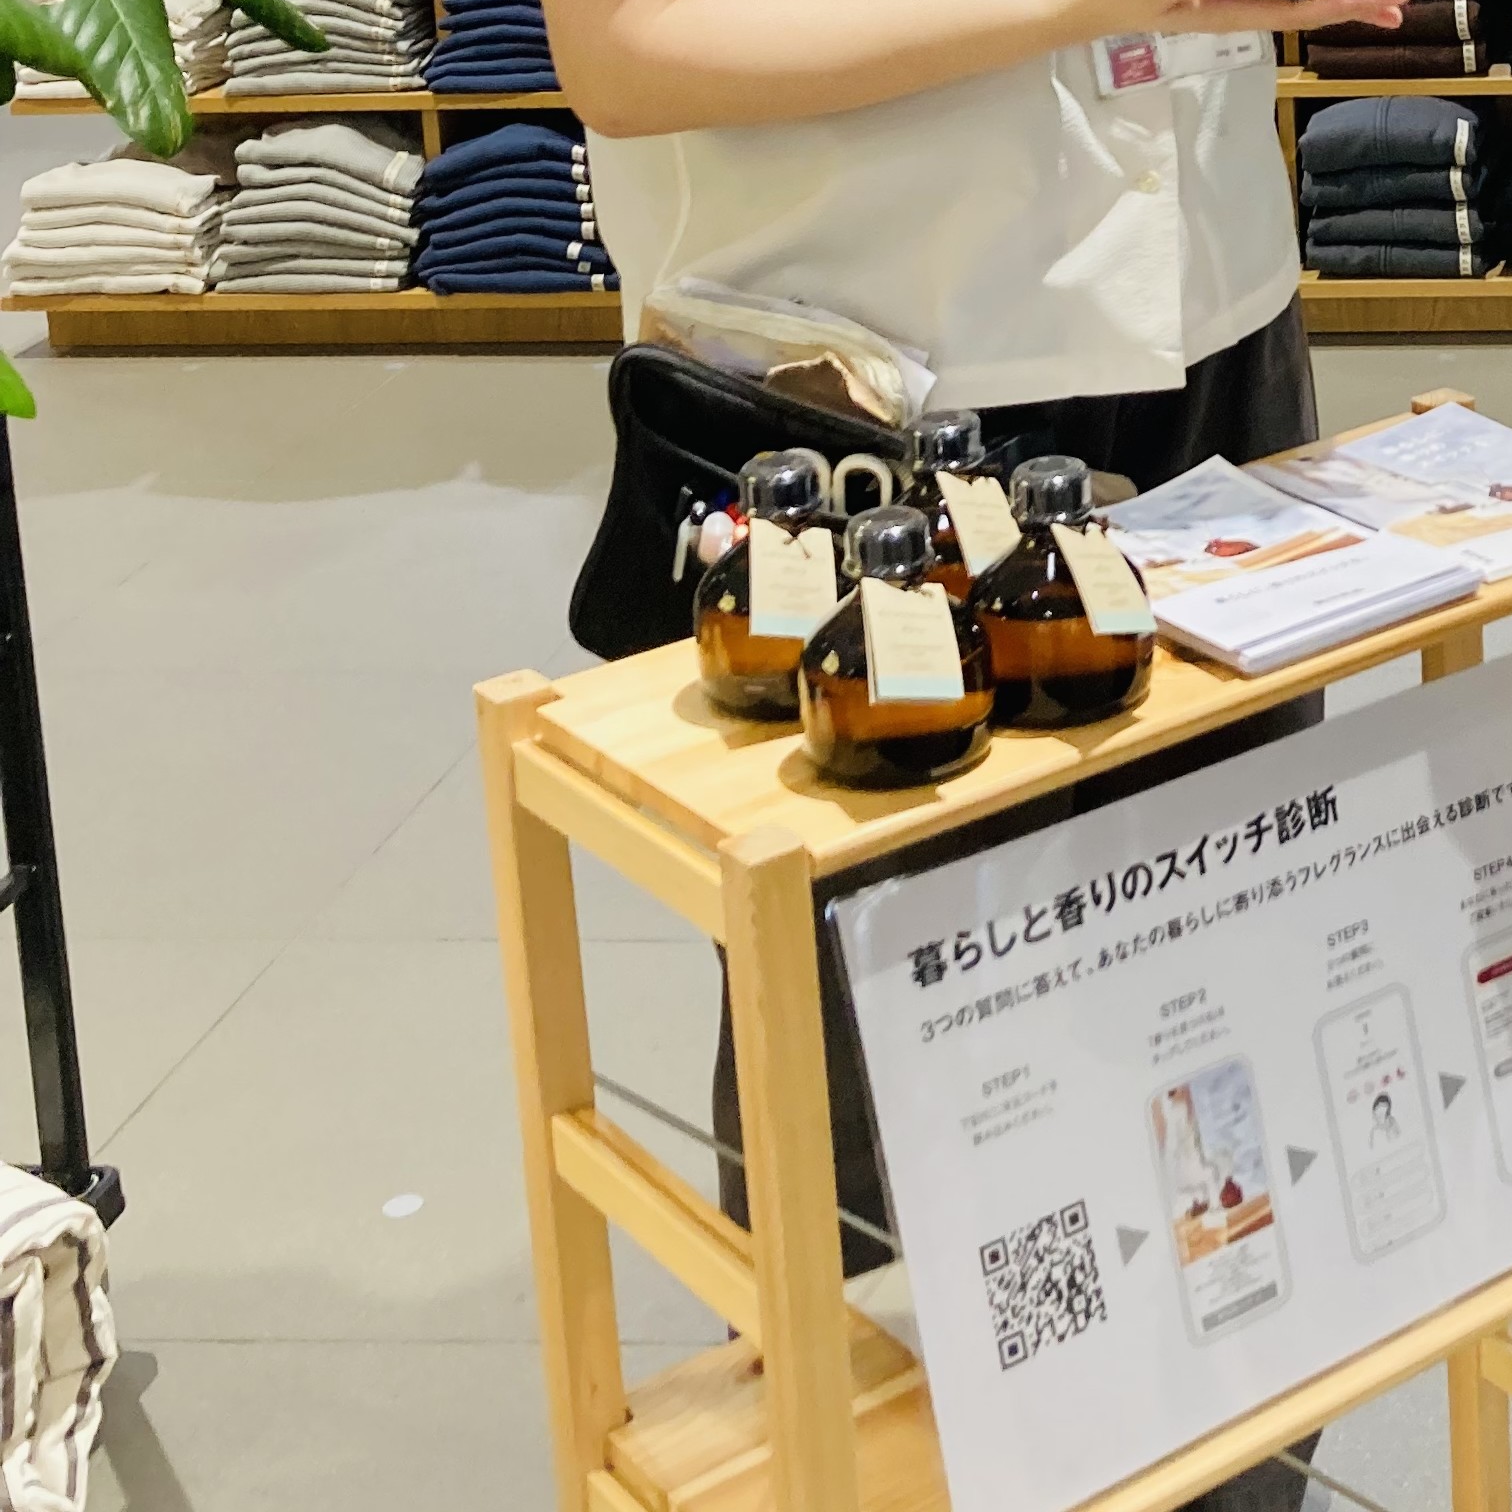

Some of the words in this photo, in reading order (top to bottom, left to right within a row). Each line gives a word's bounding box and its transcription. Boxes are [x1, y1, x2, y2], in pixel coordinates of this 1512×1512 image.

[907, 784, 1339, 988] 暮らしと香りのスイッチ診断
[1327, 918, 1369, 948] STEP3
[1159, 987, 1208, 1018] STEP2
